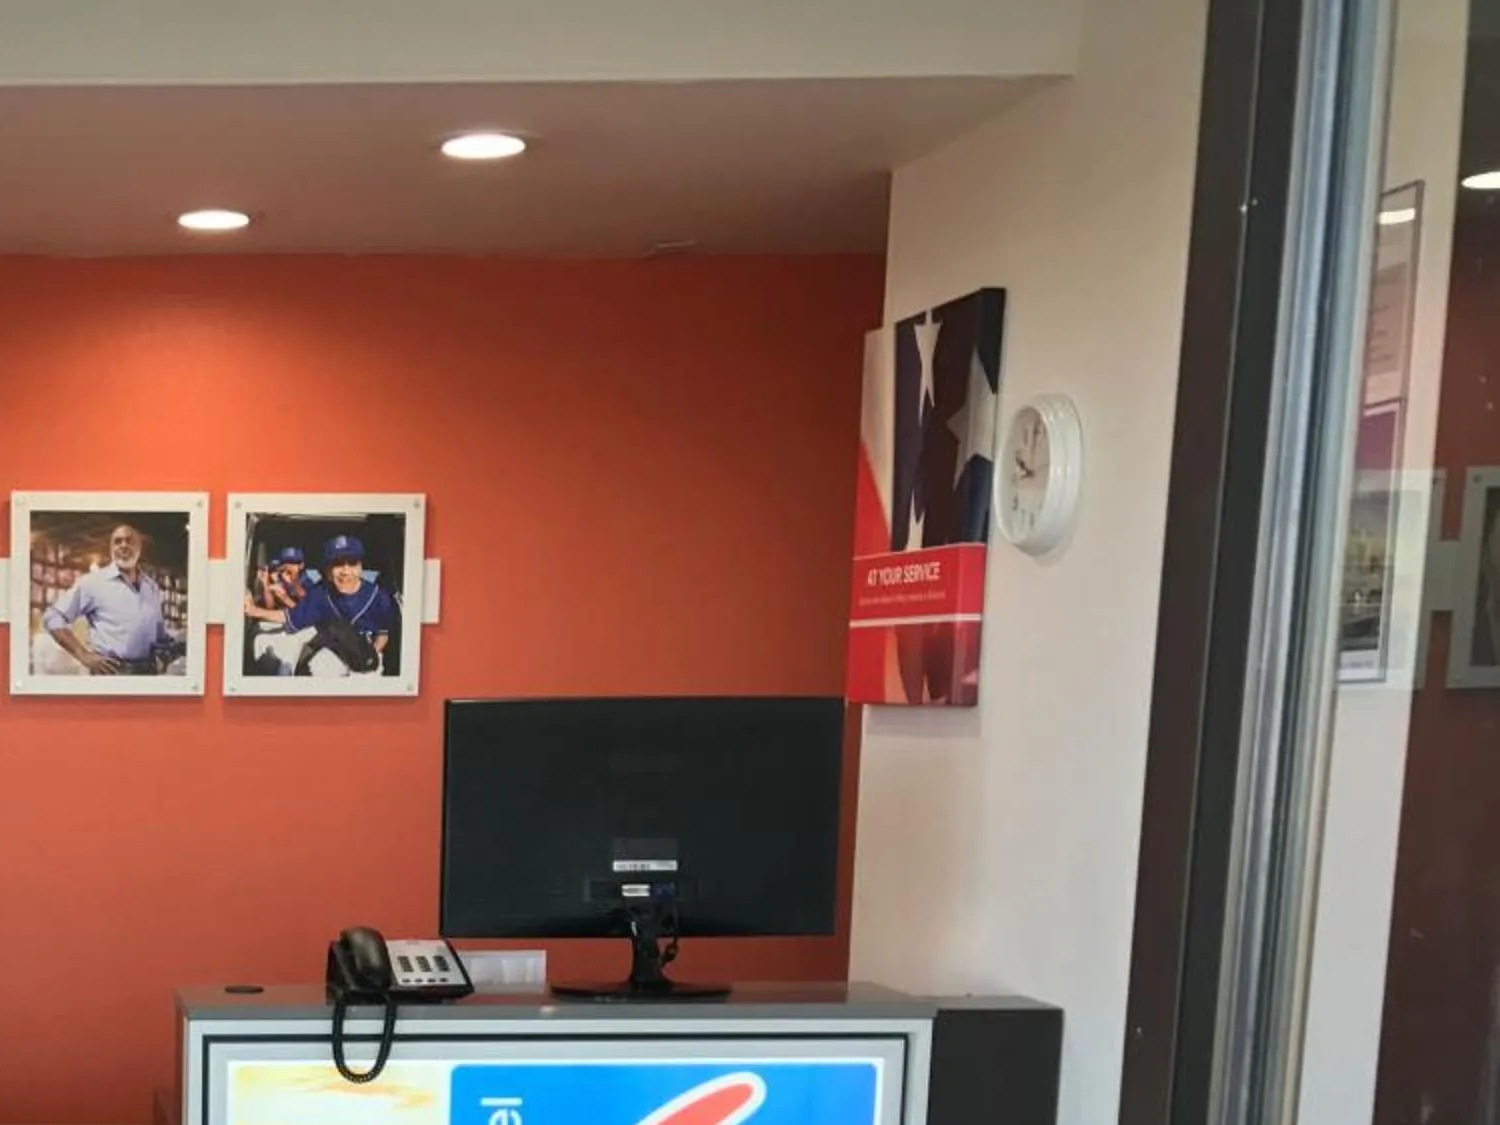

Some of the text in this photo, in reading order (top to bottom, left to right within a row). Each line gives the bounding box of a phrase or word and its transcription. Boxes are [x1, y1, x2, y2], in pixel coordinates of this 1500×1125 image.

[867, 561, 941, 587] AT YOUR SERVICE
